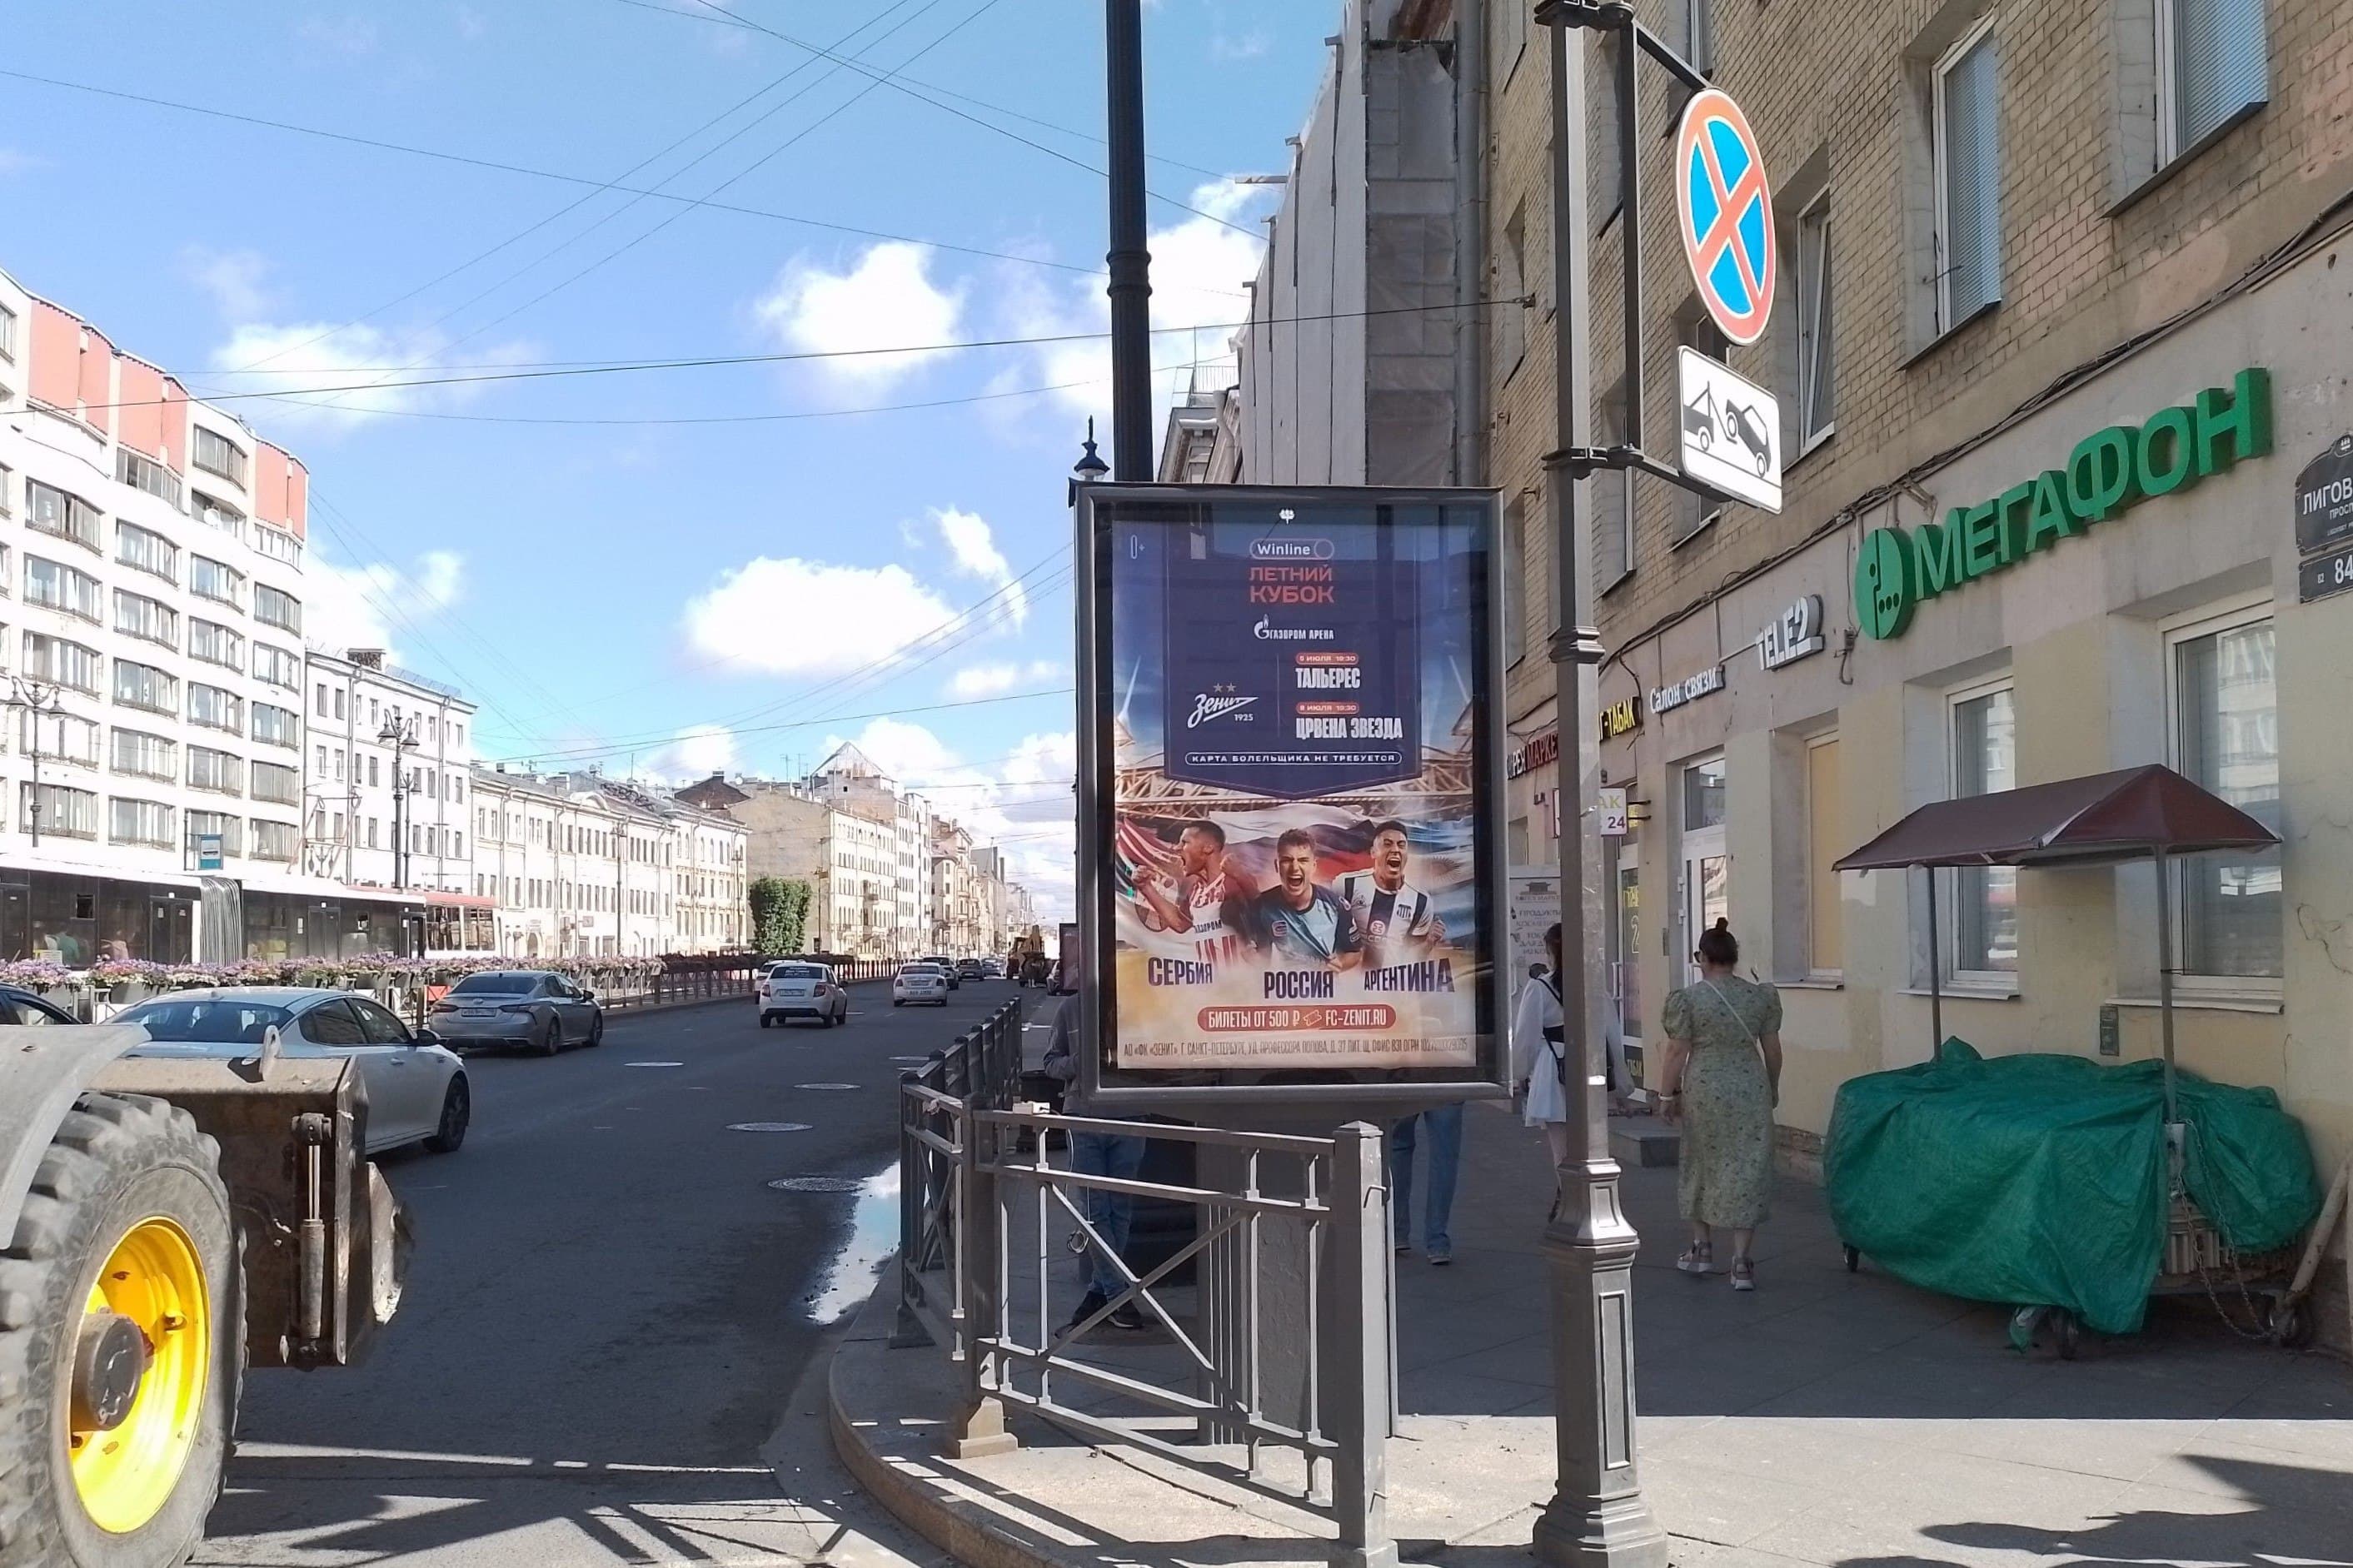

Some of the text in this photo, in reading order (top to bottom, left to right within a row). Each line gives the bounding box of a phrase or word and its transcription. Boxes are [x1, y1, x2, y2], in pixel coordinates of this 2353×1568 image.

[1915, 367, 2271, 600] МЕГАФОН
[2302, 477, 2353, 515] ЛИГОВ
[1257, 543, 1311, 555] Winline
[1249, 564, 1333, 582] ЛЕТНИЙ
[1250, 585, 1334, 604] КУБОК
[1309, 629, 1334, 640] АРЕНА
[1754, 595, 1823, 671] TELE2
[1295, 667, 1360, 689] ТАЛЬЕРЕС
[1649, 682, 1680, 714] Салон
[1234, 713, 1254, 722] 1925
[1296, 718, 1403, 739] ЦРВЕНА ЗВЕЗДА
[1192, 754, 1395, 763] КАРТА БОЛЕЛЬЩИКА НЕ ТРЕБУЕТСЯ
[1608, 815, 1626, 829] 24
[1147, 957, 1213, 987] СЕРБИЯ
[1363, 958, 1455, 993] АРГЕНТИНА
[1264, 970, 1334, 999] РОССИЯ
[1208, 1010, 1251, 1028] БИЛЕТЫ
[1254, 1010, 1267, 1028] ОТ
[1269, 1010, 1289, 1028] 500
[1325, 1008, 1387, 1027] FC-ZENIT.RU
